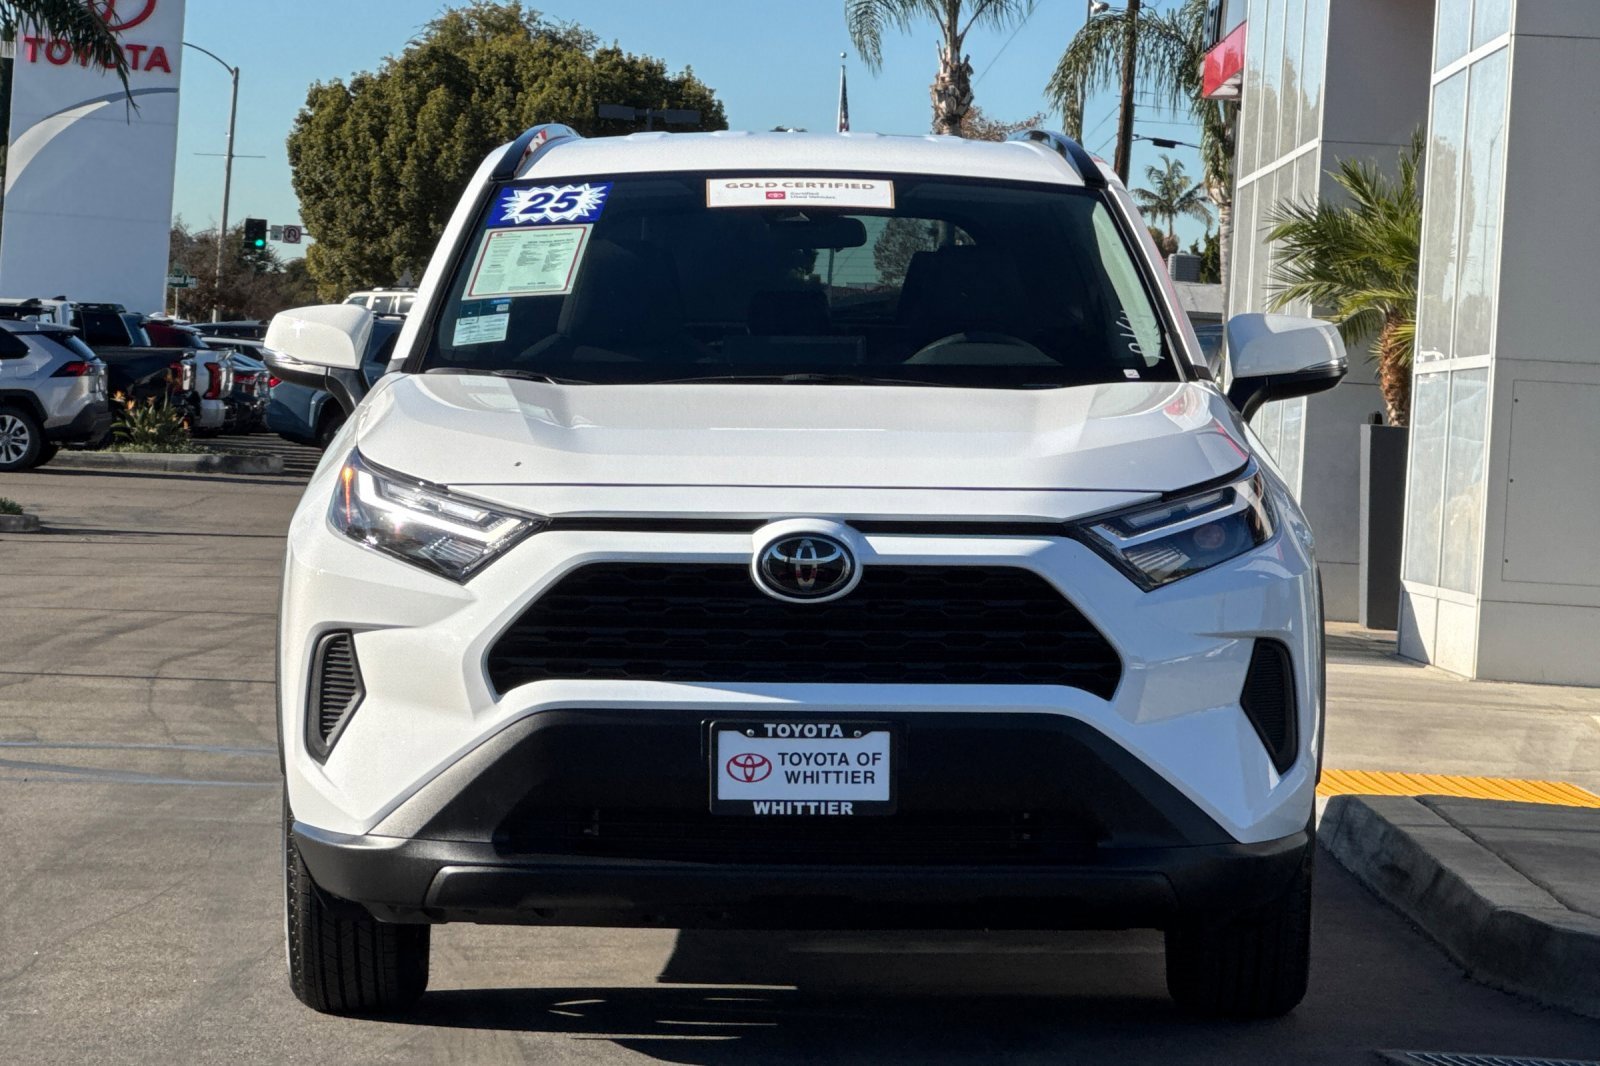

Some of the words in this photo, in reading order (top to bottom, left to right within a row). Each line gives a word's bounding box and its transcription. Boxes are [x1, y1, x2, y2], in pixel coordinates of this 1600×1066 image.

[519, 192, 583, 214] 25
[764, 724, 843, 737] TOYOTA
[778, 752, 850, 766] TOYOTA
[857, 752, 882, 766] OF
[785, 770, 875, 784] WHITTIER
[753, 801, 853, 815] WHITTIER
